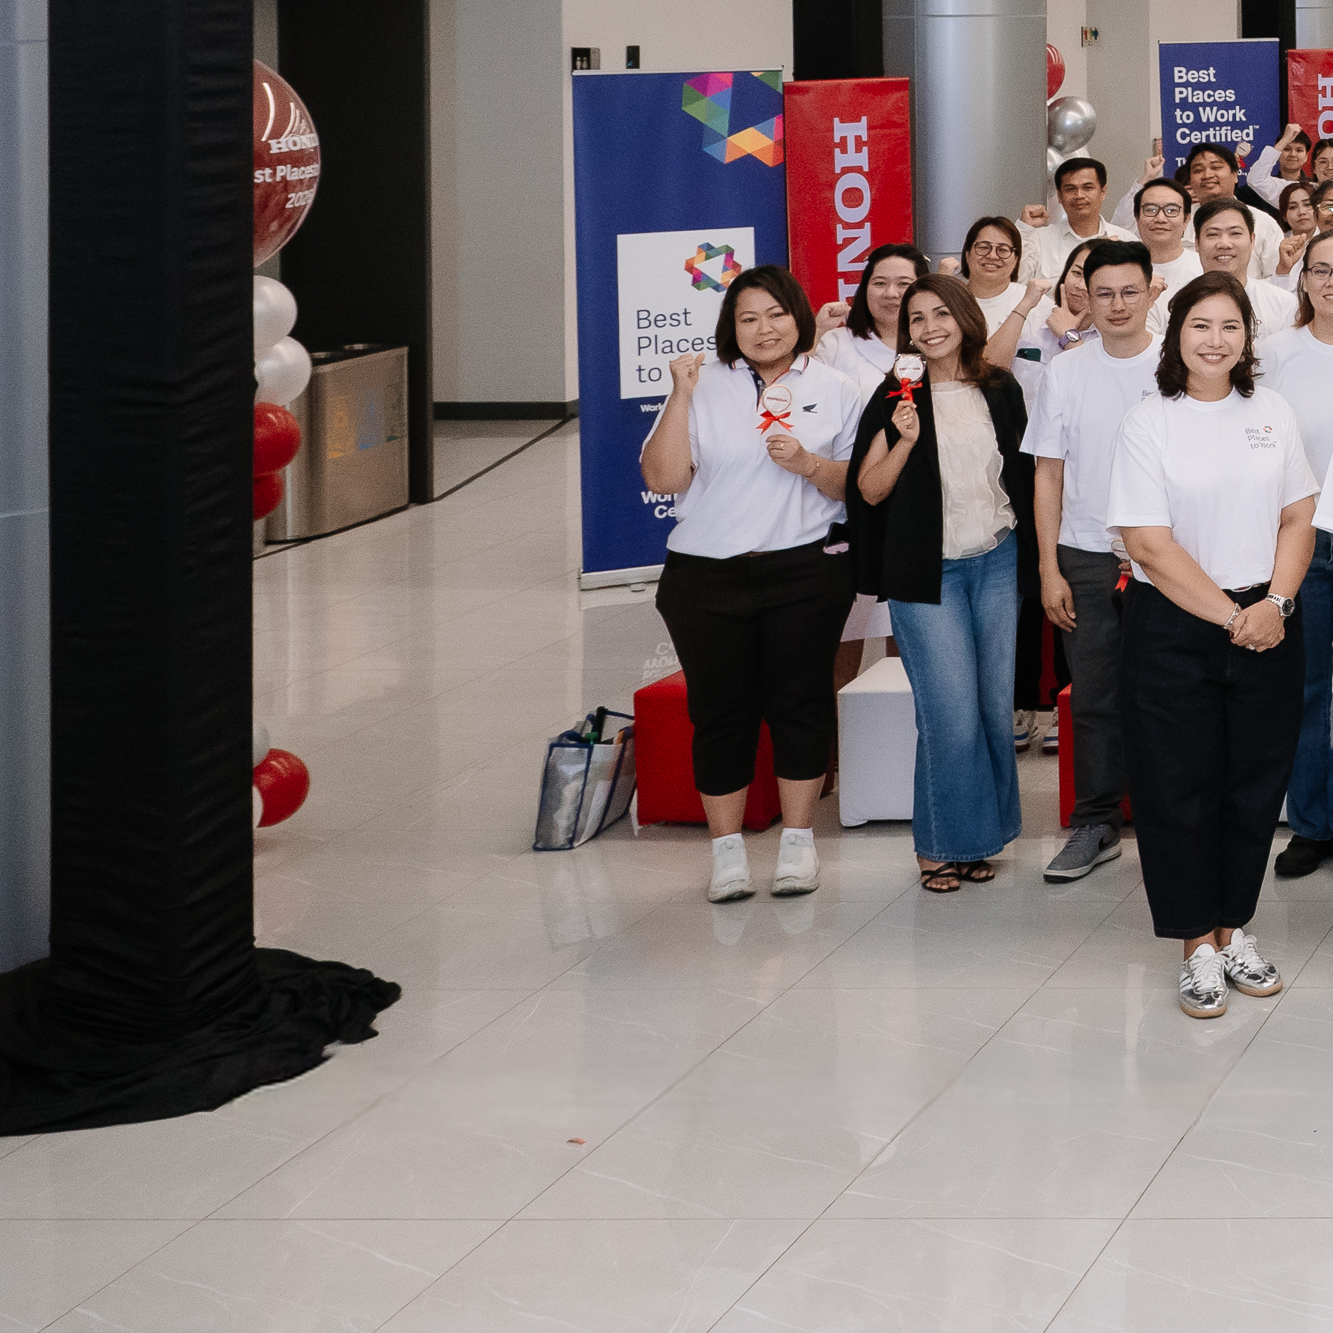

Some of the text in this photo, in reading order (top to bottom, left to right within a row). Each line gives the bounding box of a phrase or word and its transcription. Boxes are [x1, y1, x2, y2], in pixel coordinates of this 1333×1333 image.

[1174, 66, 1216, 84] Best
[1175, 88, 1236, 104] Places
[1175, 106, 1246, 124] to Work
[636, 308, 692, 330] Best
[636, 333, 717, 356] Places
[636, 365, 662, 384] to
